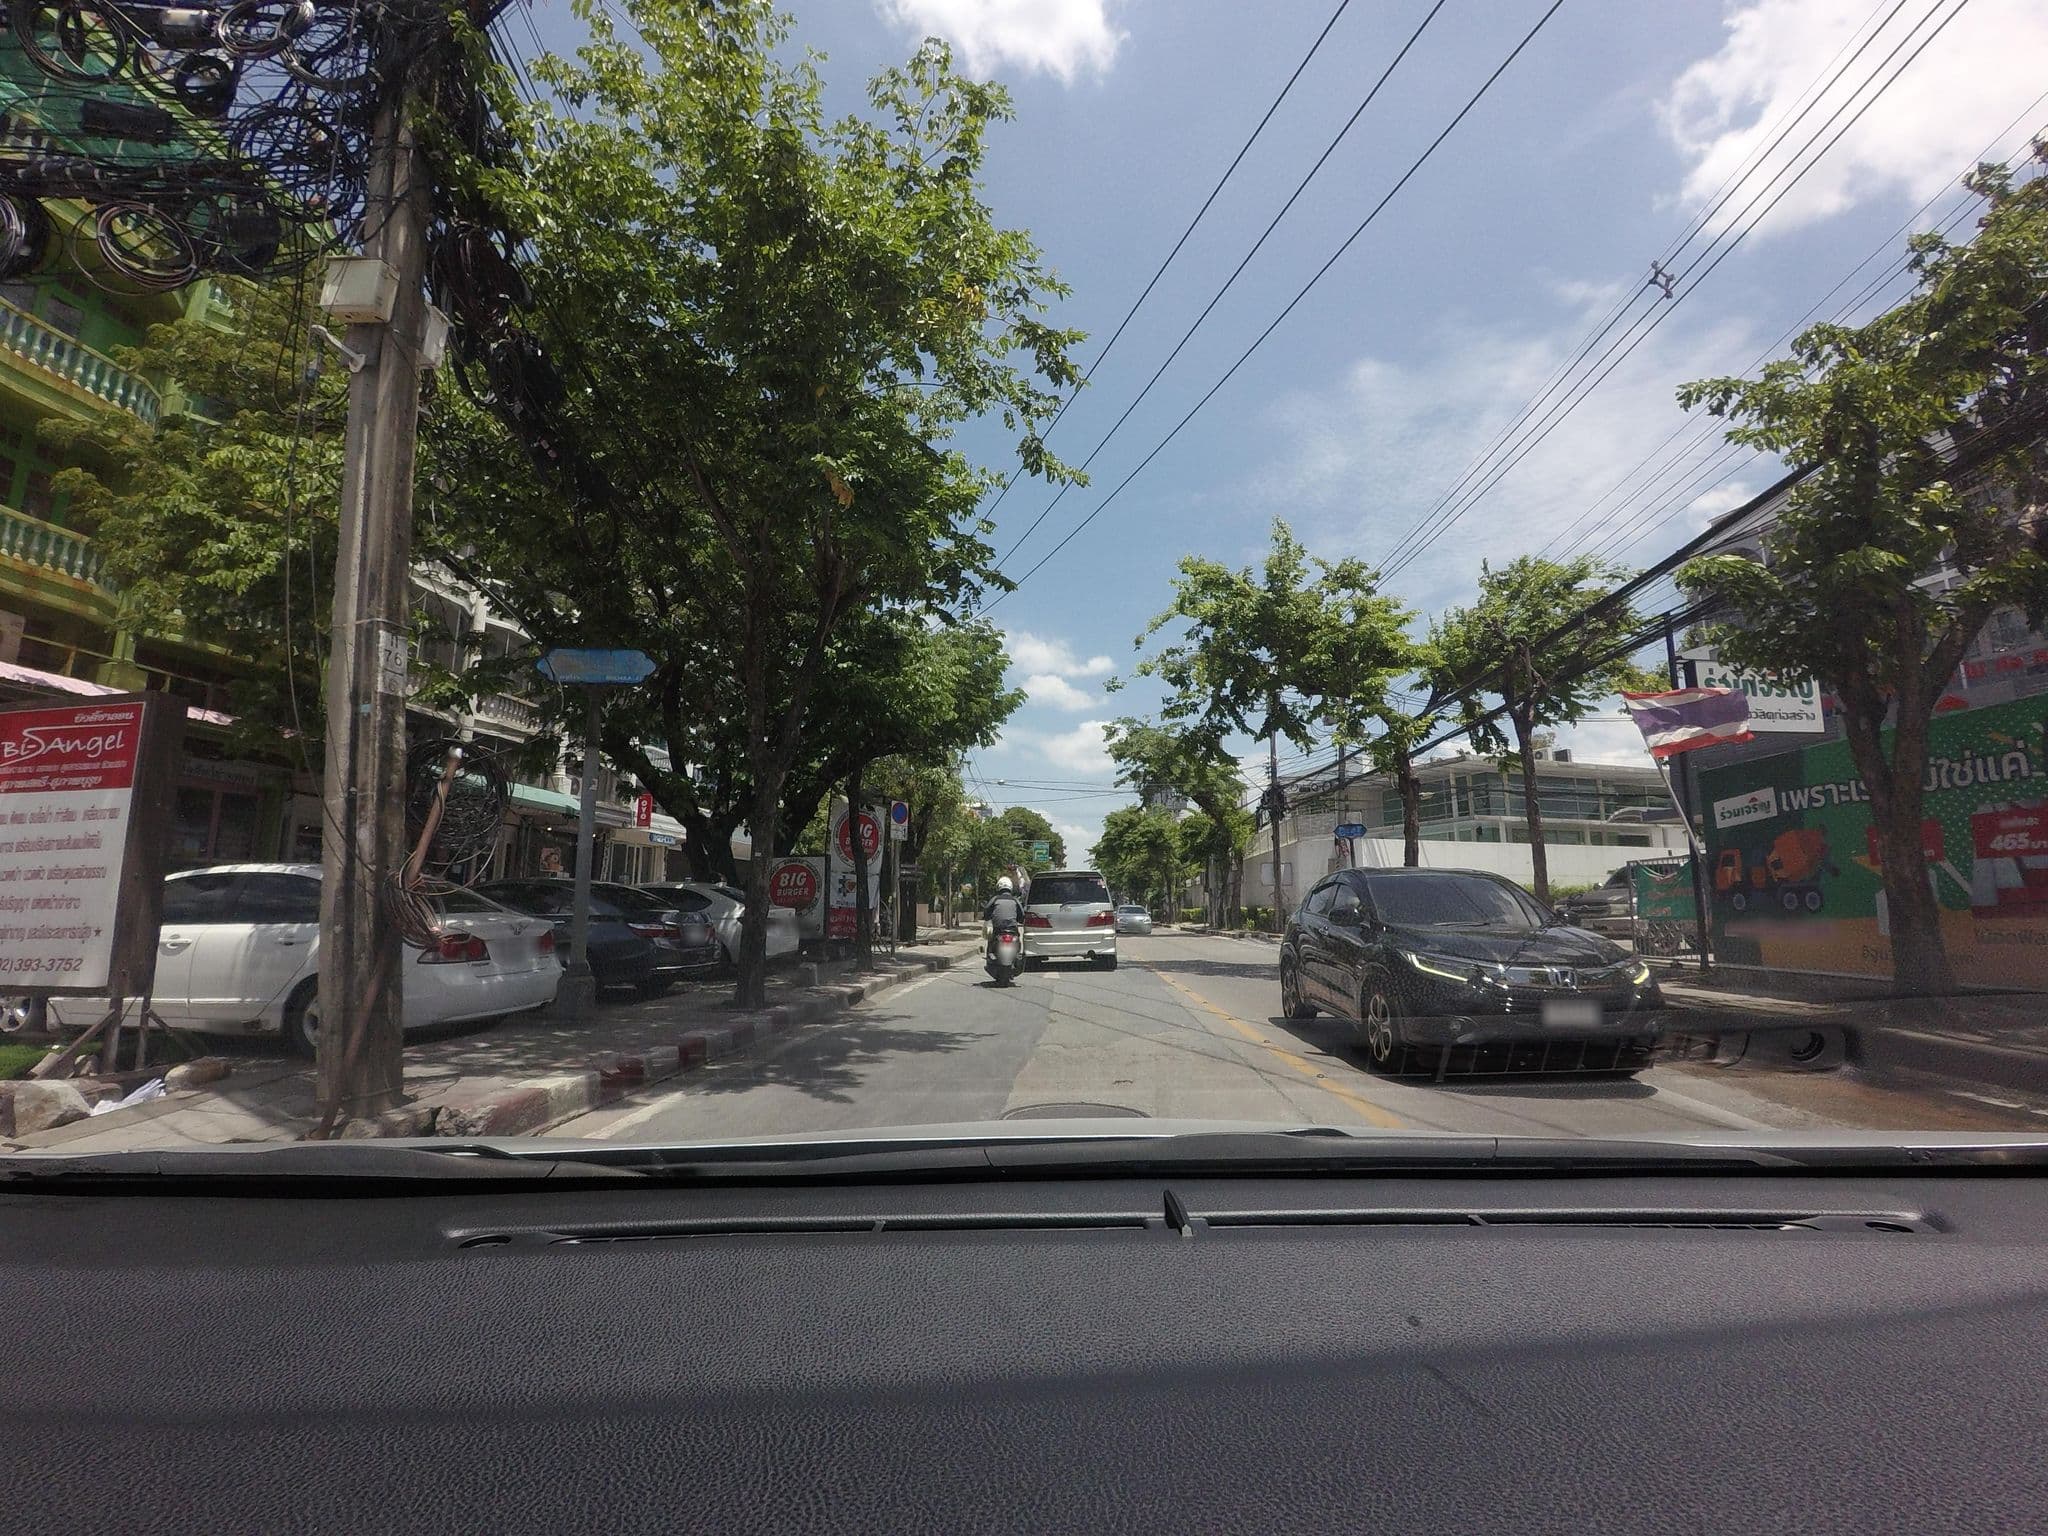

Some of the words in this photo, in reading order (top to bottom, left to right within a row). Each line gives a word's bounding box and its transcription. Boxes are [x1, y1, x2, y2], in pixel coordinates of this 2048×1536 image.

[640, 800, 648, 820] OYO
[779, 871, 807, 887] BIG
[776, 887, 809, 897] BURGER
[0, 958, 84, 974] 2)393-3752
